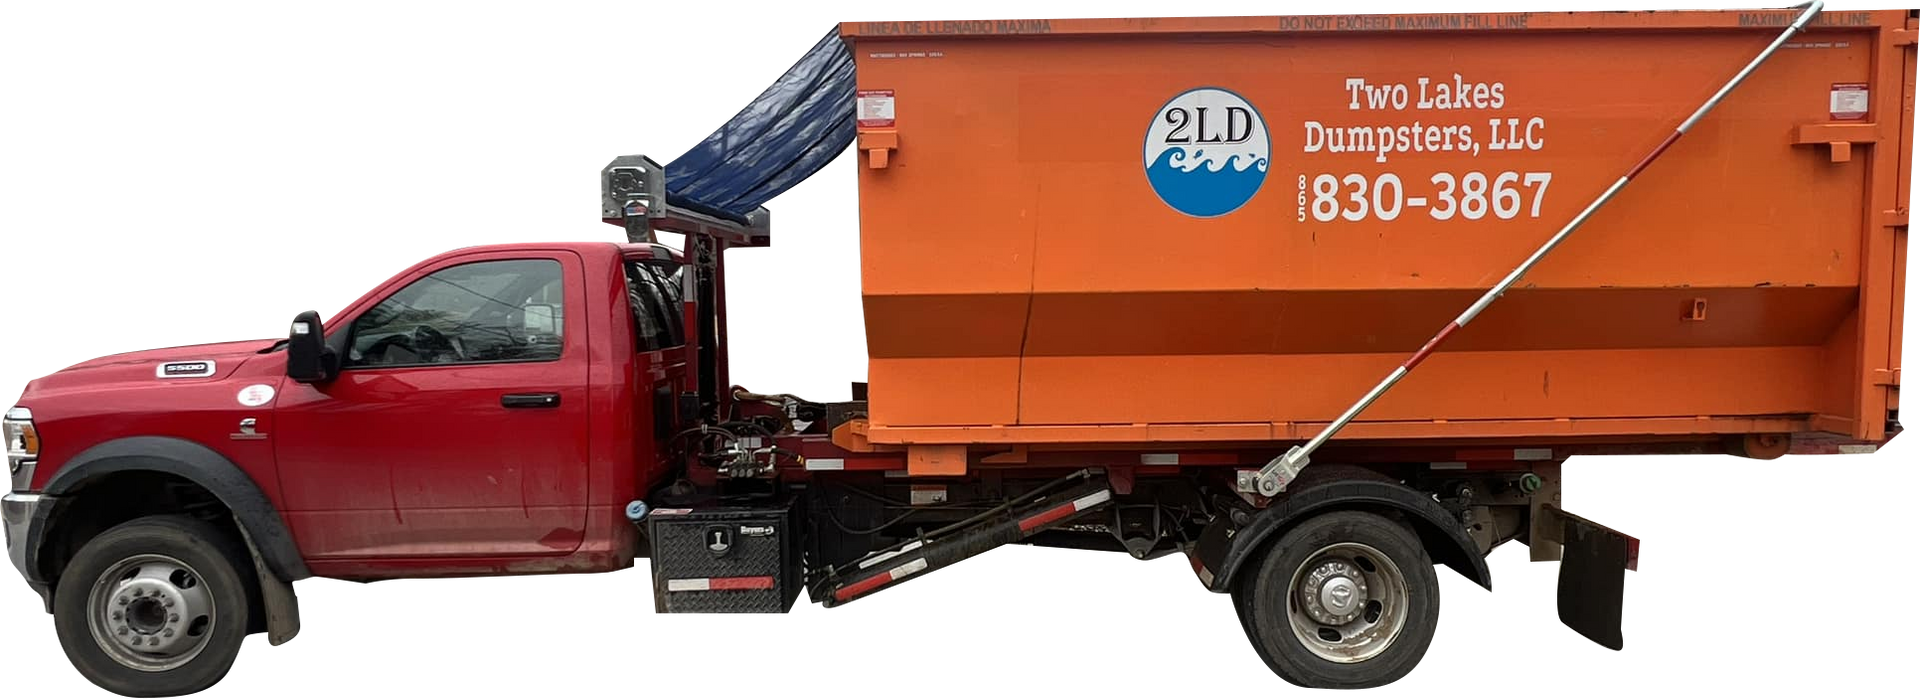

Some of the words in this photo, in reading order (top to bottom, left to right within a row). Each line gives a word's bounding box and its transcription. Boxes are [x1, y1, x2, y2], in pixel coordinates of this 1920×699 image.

[905, 22, 922, 34] DE
[926, 21, 993, 34] LLENADO
[1279, 17, 1300, 31] DO
[1304, 17, 1332, 30] NOT
[1394, 16, 1461, 29] MAXIMUM
[1464, 15, 1493, 29] FILL
[1496, 15, 1528, 29] LINE
[1738, 13, 1798, 26] MAXIMU
[1842, 12, 1870, 26] LINE
[1345, 78, 1409, 110] Two
[1416, 73, 1505, 109] Lakes
[1164, 107, 1255, 145] 2LD
[1304, 121, 1480, 163] Dumpsters,
[1488, 117, 1544, 150] LLC
[1311, 171, 1552, 222] 830-3867
[167, 363, 206, 372] 5500
